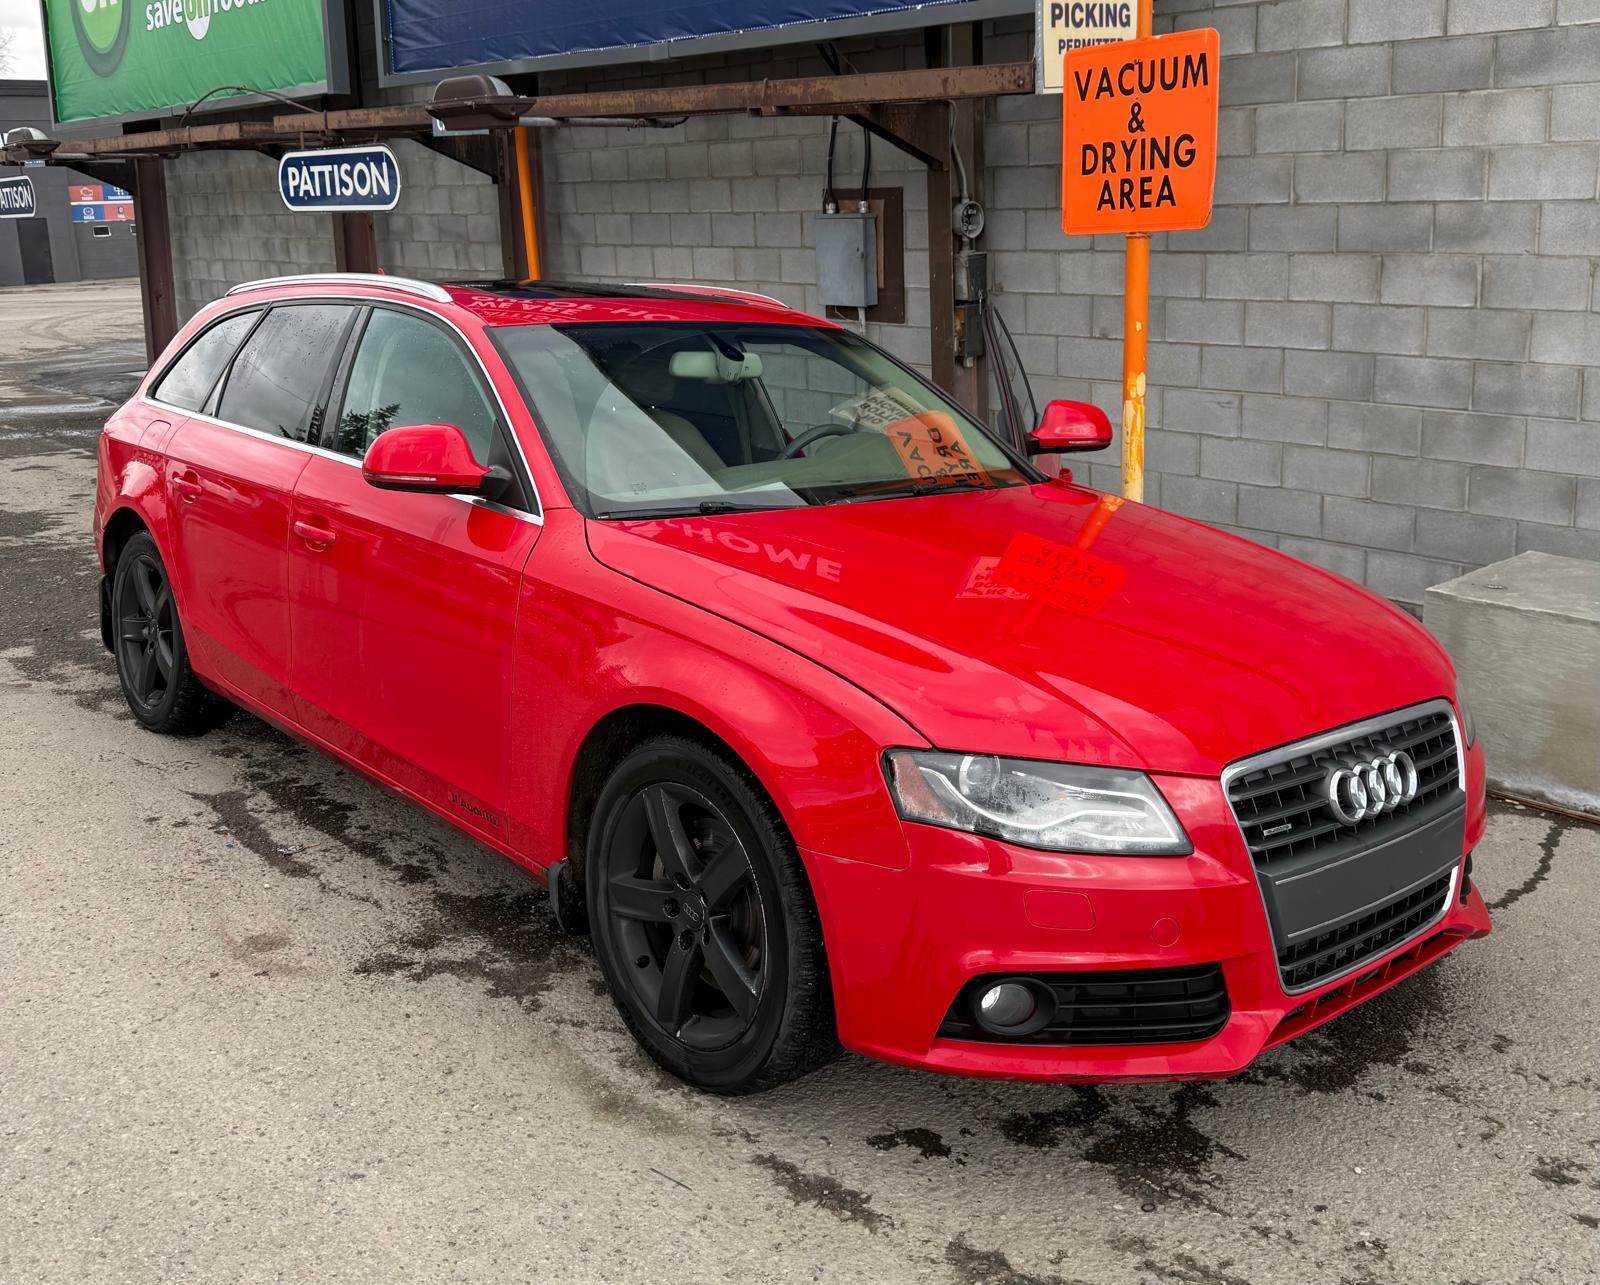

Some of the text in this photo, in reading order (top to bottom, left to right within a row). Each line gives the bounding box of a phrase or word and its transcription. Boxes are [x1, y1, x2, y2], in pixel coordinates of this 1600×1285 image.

[1051, 3, 1131, 28] PICKING
[1074, 53, 1208, 101] VACUUM
[1128, 102, 1145, 133] &
[1081, 134, 1196, 175] DRYING
[0, 185, 33, 209] ATTISON
[287, 162, 391, 197] PATTISON
[1097, 175, 1176, 212] AREA
